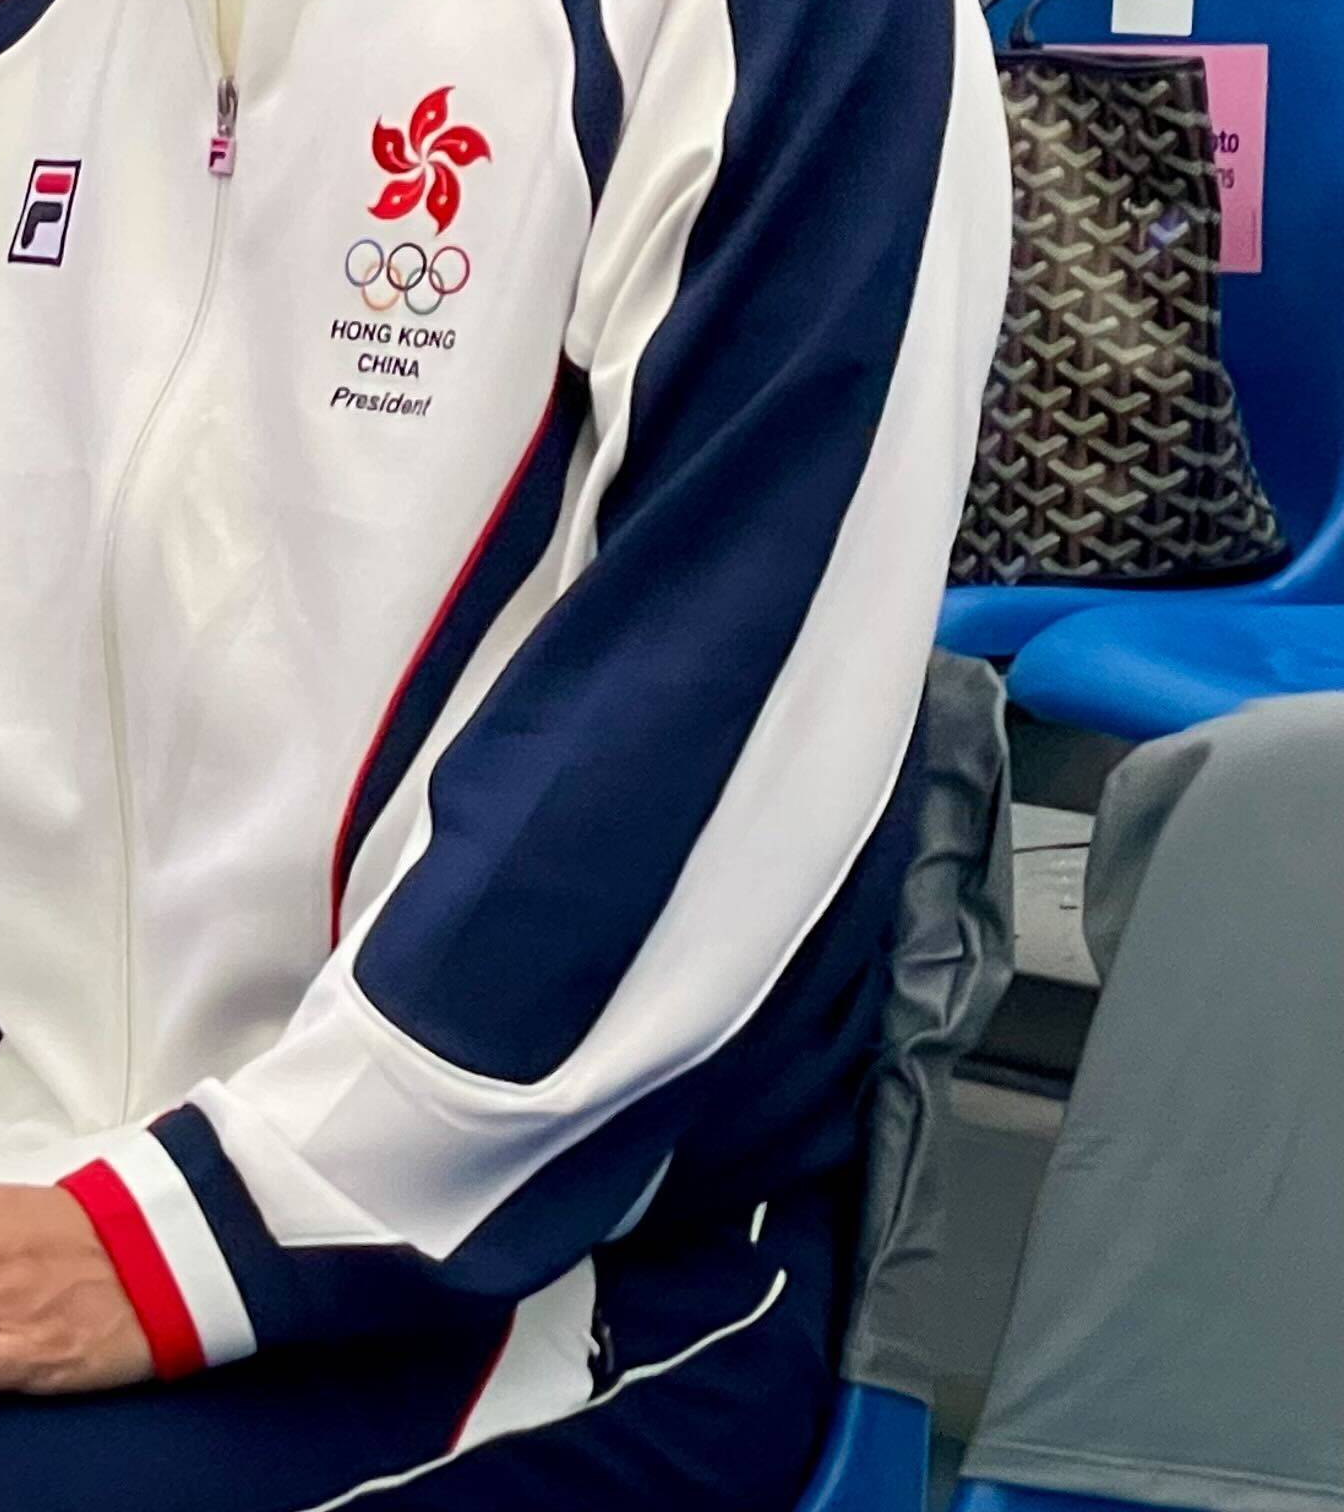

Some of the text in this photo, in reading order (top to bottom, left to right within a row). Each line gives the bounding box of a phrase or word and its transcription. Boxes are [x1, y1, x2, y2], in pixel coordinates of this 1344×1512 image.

[330, 319, 456, 350] HONG KONG
[357, 352, 420, 379] CHINA
[330, 386, 433, 417] President
